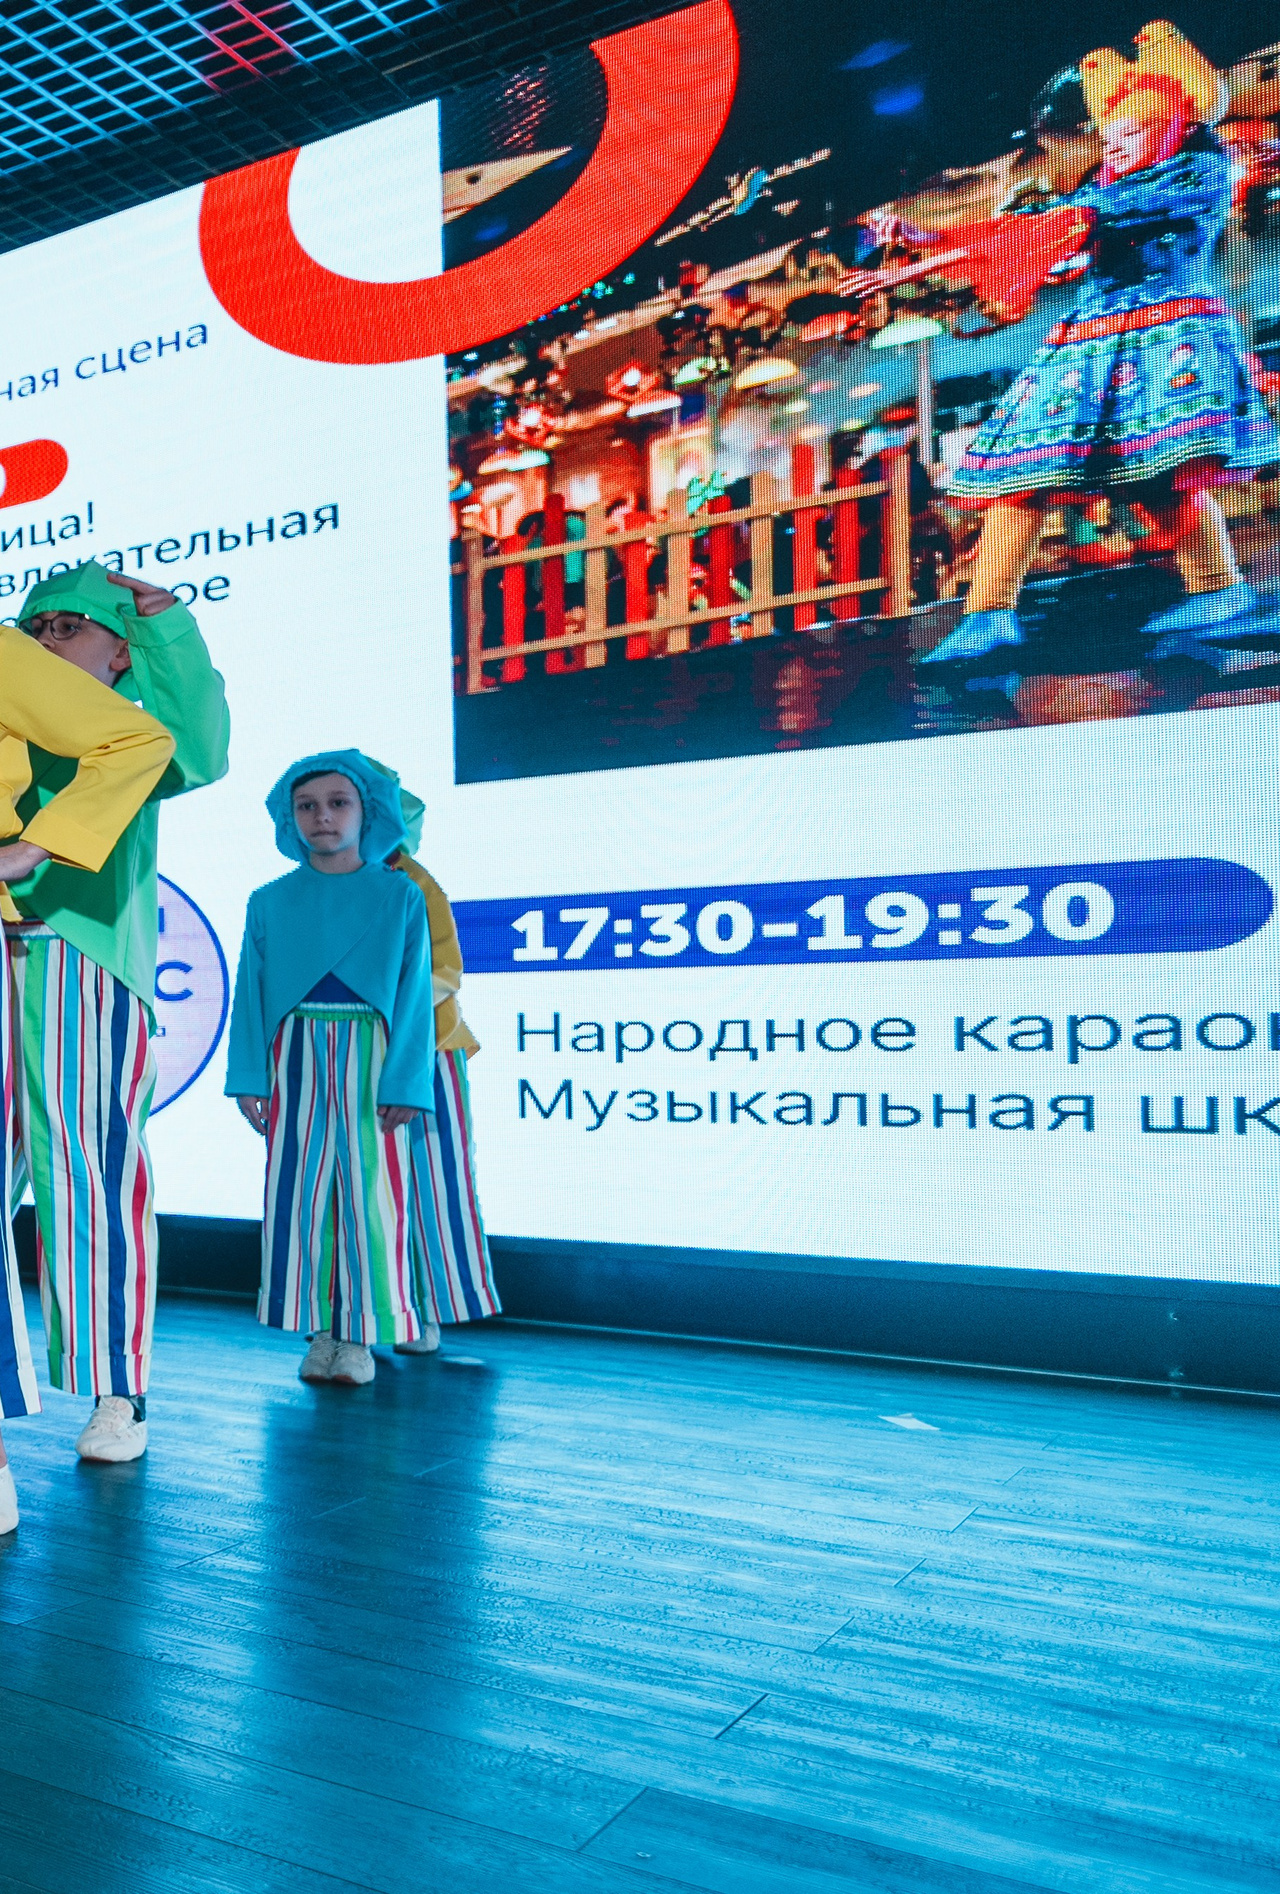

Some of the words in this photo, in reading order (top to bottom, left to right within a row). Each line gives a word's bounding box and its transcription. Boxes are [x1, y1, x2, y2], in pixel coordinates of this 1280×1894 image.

[75, 323, 208, 380] сцена
[511, 881, 1115, 961] 17:30-19:30
[517, 1011, 917, 1063] Народное
[953, 1012, 1280, 1065] карао
[518, 1078, 1095, 1132] Музыкальная
[1140, 1094, 1280, 1136] шк
